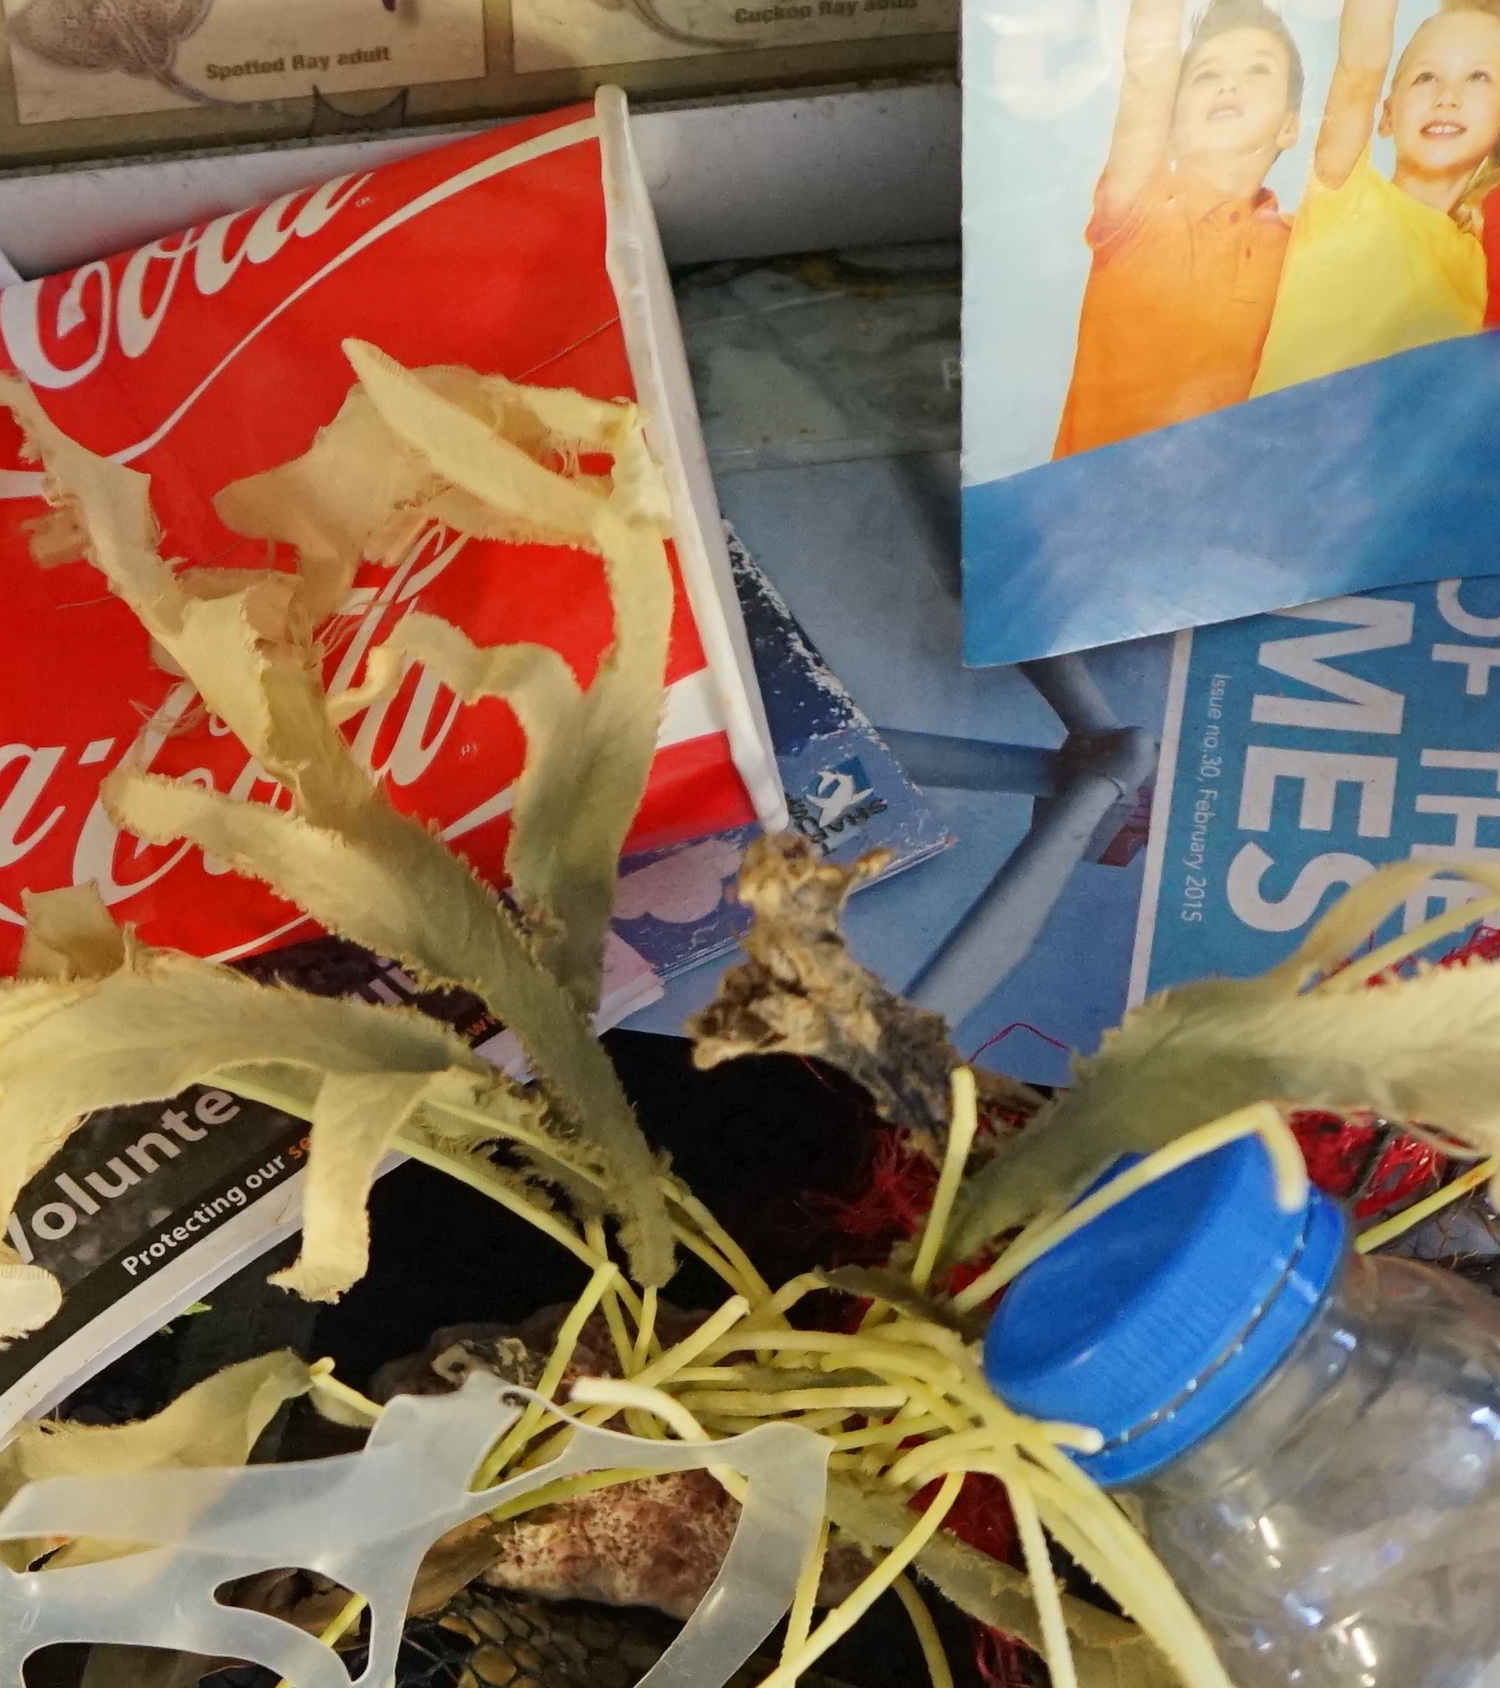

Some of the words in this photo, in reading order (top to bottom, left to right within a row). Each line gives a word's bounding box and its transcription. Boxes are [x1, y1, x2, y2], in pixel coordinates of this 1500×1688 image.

[205, 56, 286, 82] Spotted
[291, 53, 331, 72] Ray
[336, 45, 391, 67] adult
[1205, 672, 1233, 731] Issue
[1183, 787, 1220, 873] February
[1179, 871, 1209, 923] 2015
[120, 1183, 248, 1277] Protecting
[244, 1153, 286, 1191] our
